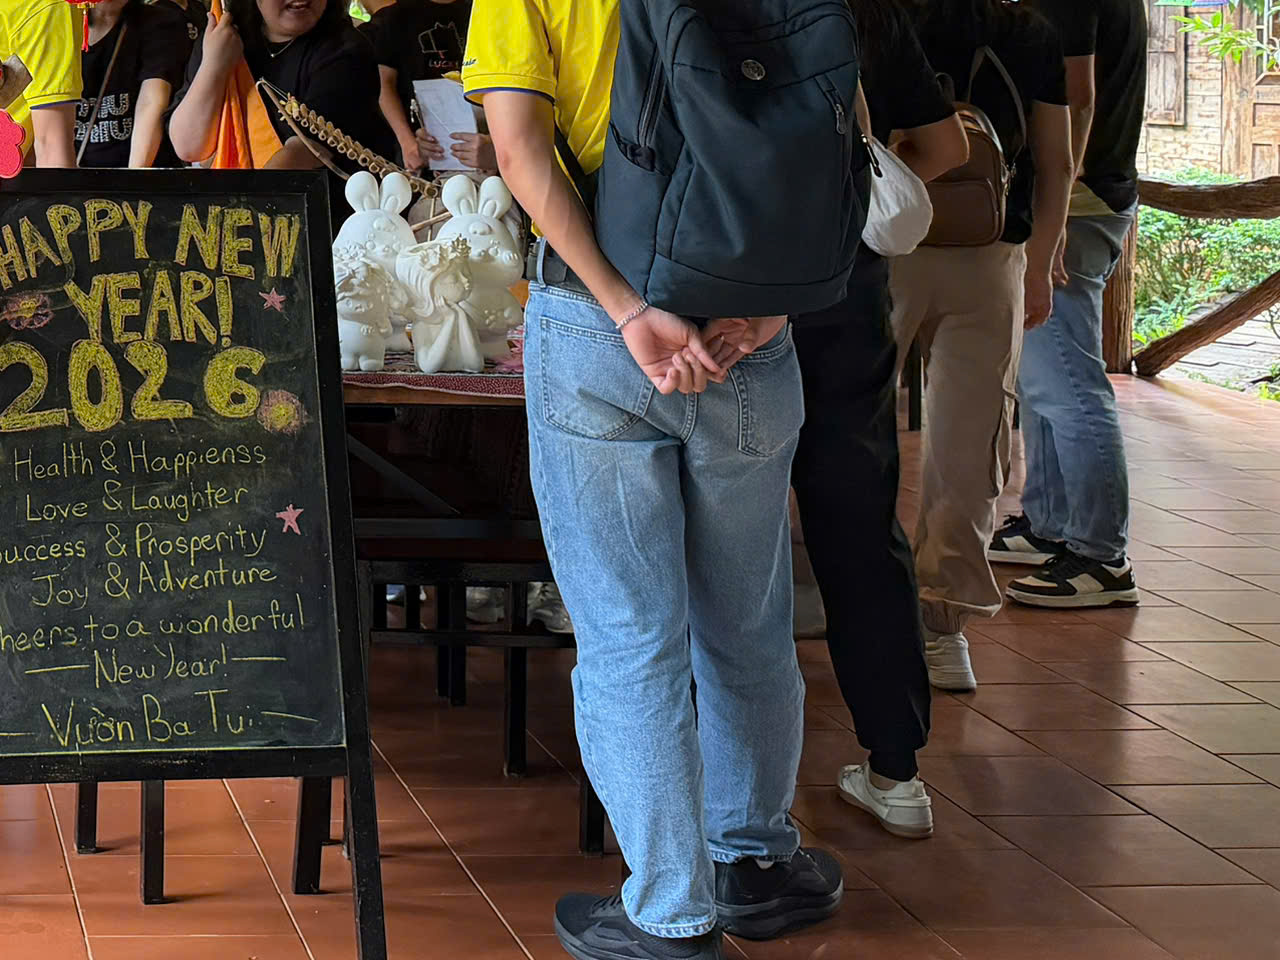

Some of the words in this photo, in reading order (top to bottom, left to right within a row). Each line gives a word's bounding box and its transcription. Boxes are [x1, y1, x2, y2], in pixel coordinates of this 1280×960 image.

[175, 203, 301, 279] NEW
[64, 270, 234, 348] YEAR!
[13, 442, 94, 482] Health
[100, 439, 120, 474] &
[25, 494, 89, 523] Love
[102, 479, 124, 512] &
[131, 482, 250, 522] Laughter
[104, 522, 129, 558] &
[135, 523, 268, 566] Prosperity
[31, 573, 89, 611] Joy
[104, 562, 131, 600] &
[138, 558, 278, 594] Adventure
[84, 613, 119, 641] to
[127, 619, 152, 638] a
[159, 593, 307, 634] wonderful
[92, 649, 156, 688] New
[154, 642, 230, 685] Year!
[141, 693, 196, 743] Ba
